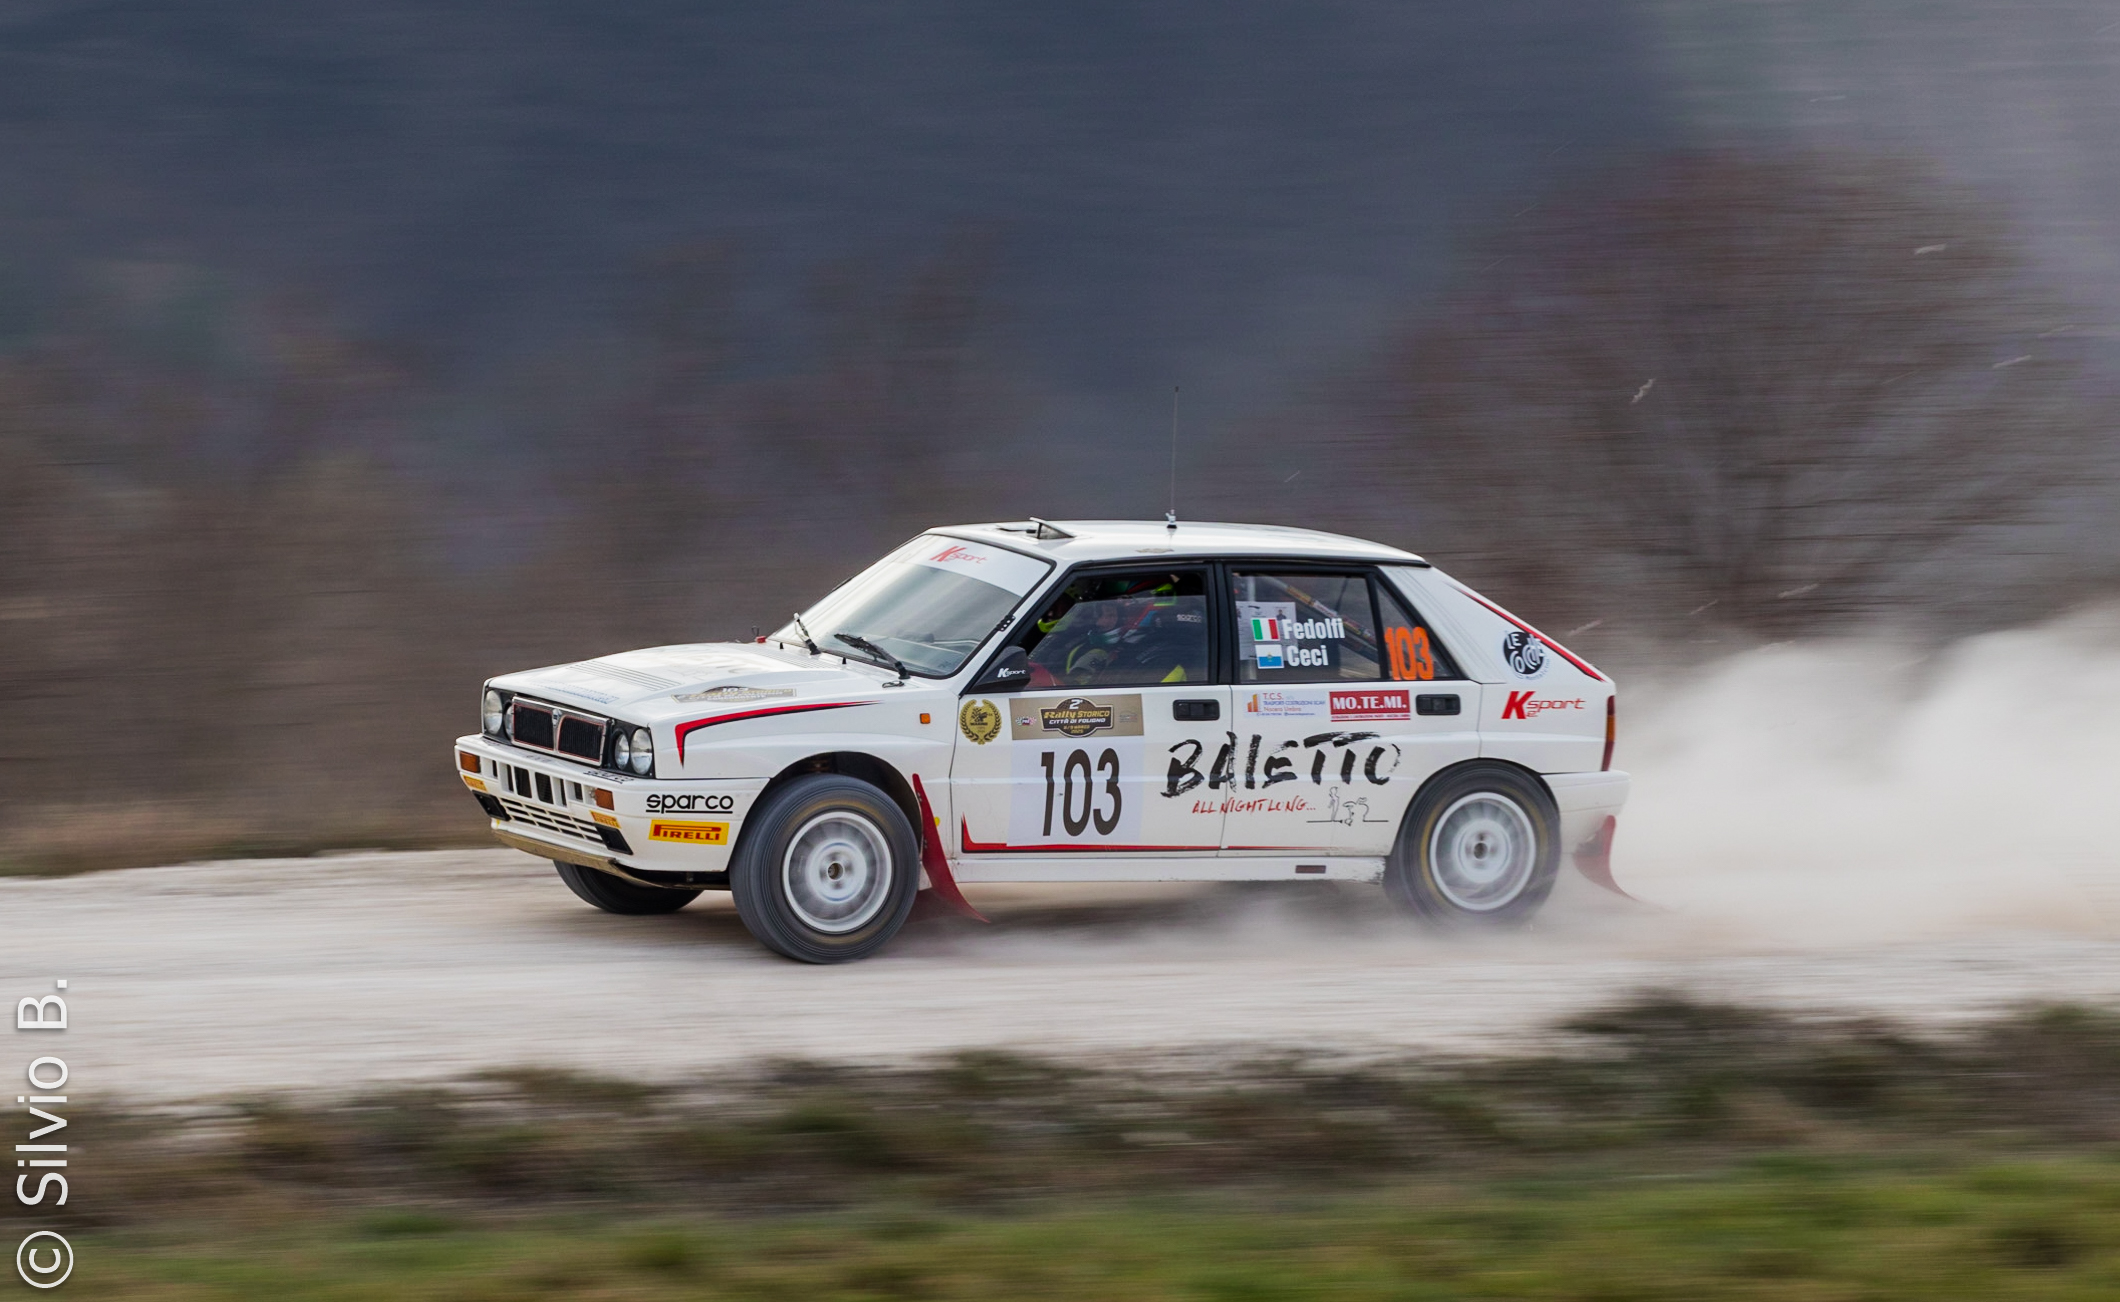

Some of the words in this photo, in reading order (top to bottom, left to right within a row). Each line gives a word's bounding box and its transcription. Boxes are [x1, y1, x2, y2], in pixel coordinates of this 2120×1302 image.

[1281, 618, 1345, 640] Fedolfi
[1286, 645, 1328, 666] Ceci
[1384, 626, 1434, 680] 103
[1263, 692, 1283, 701] T.C.S.
[1332, 695, 1407, 710] MO.TE.MI.
[1044, 711, 1076, 719] Rally
[1077, 710, 1110, 718] STORICO
[1041, 747, 1122, 837] 103
[645, 794, 734, 814] sparco
[1192, 800, 1217, 814] ALL
[1219, 796, 1267, 813] NIGHT
[653, 824, 722, 841] PIRELLI
